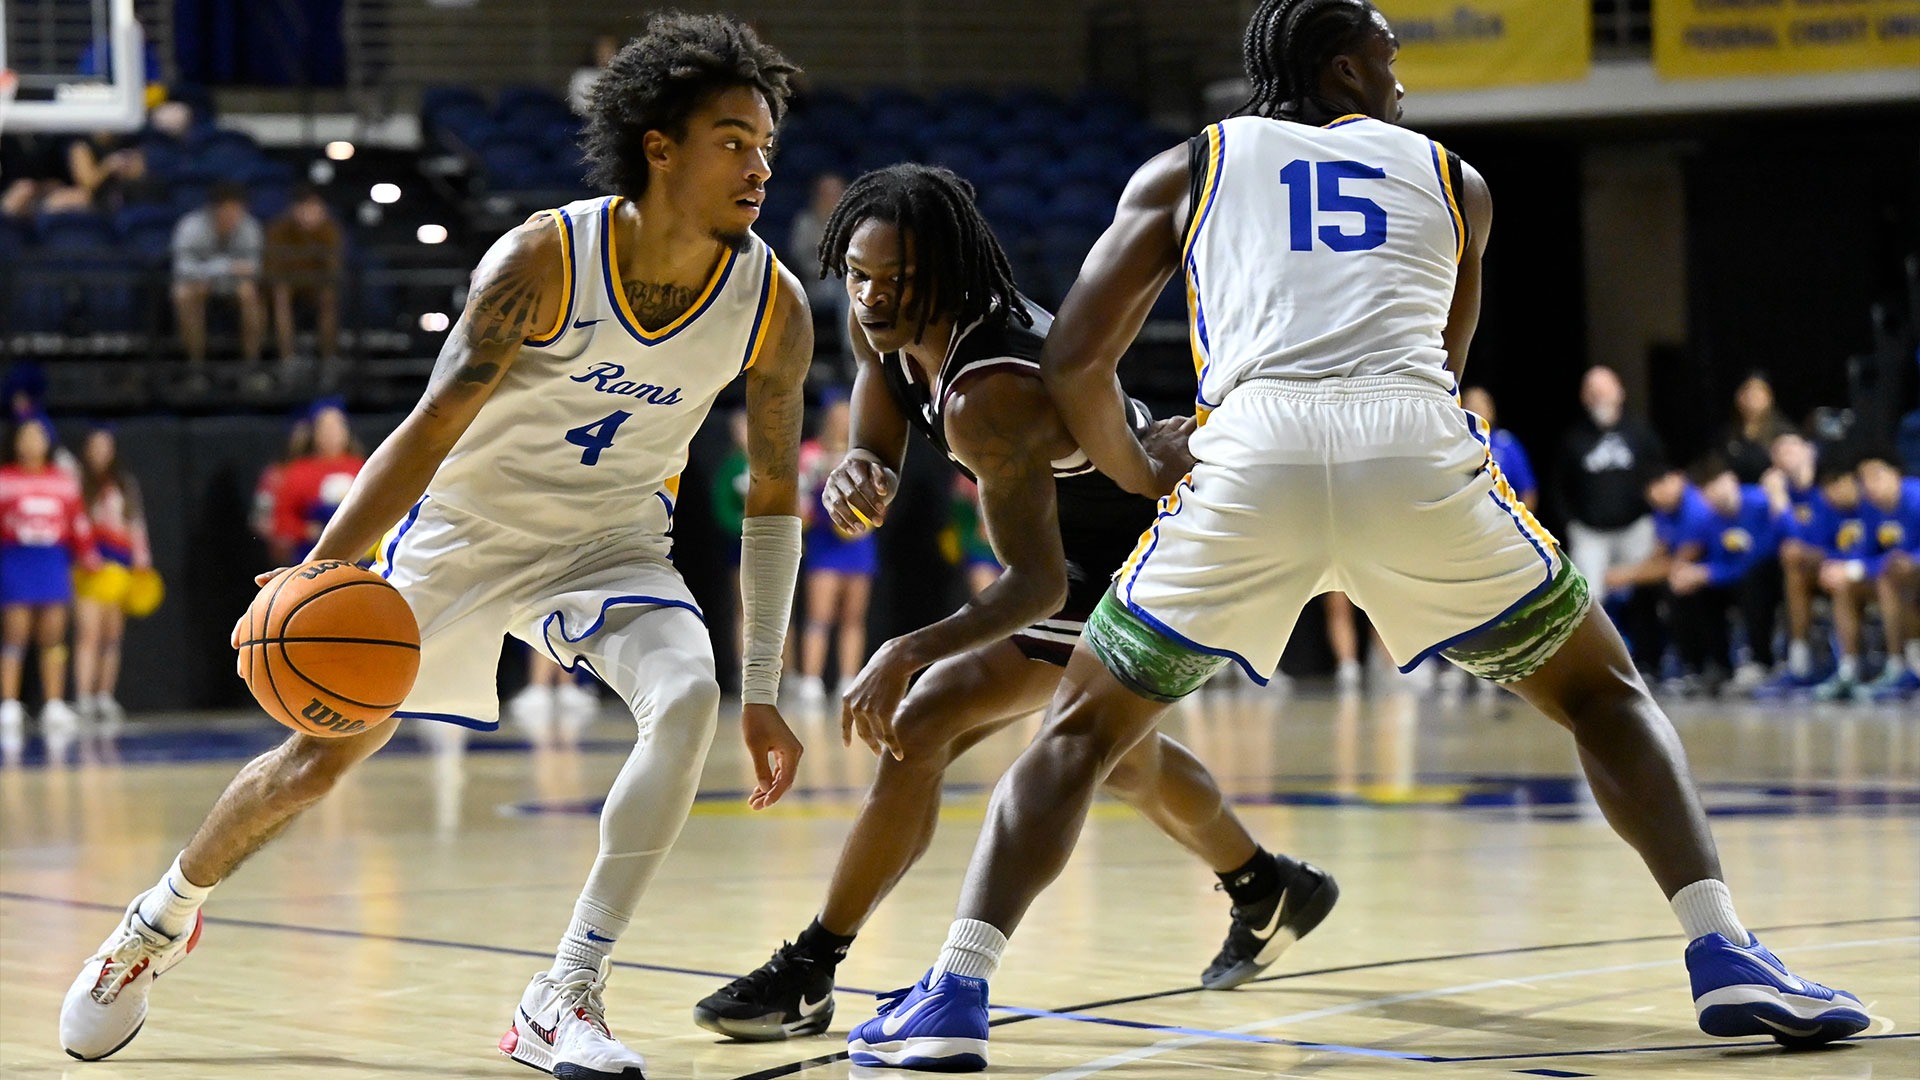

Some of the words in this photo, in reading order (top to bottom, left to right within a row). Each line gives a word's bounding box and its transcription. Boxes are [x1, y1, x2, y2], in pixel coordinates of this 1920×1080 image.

[1280, 159, 1387, 252] 15
[569, 362, 683, 405] Rams
[564, 410, 633, 466] 4
